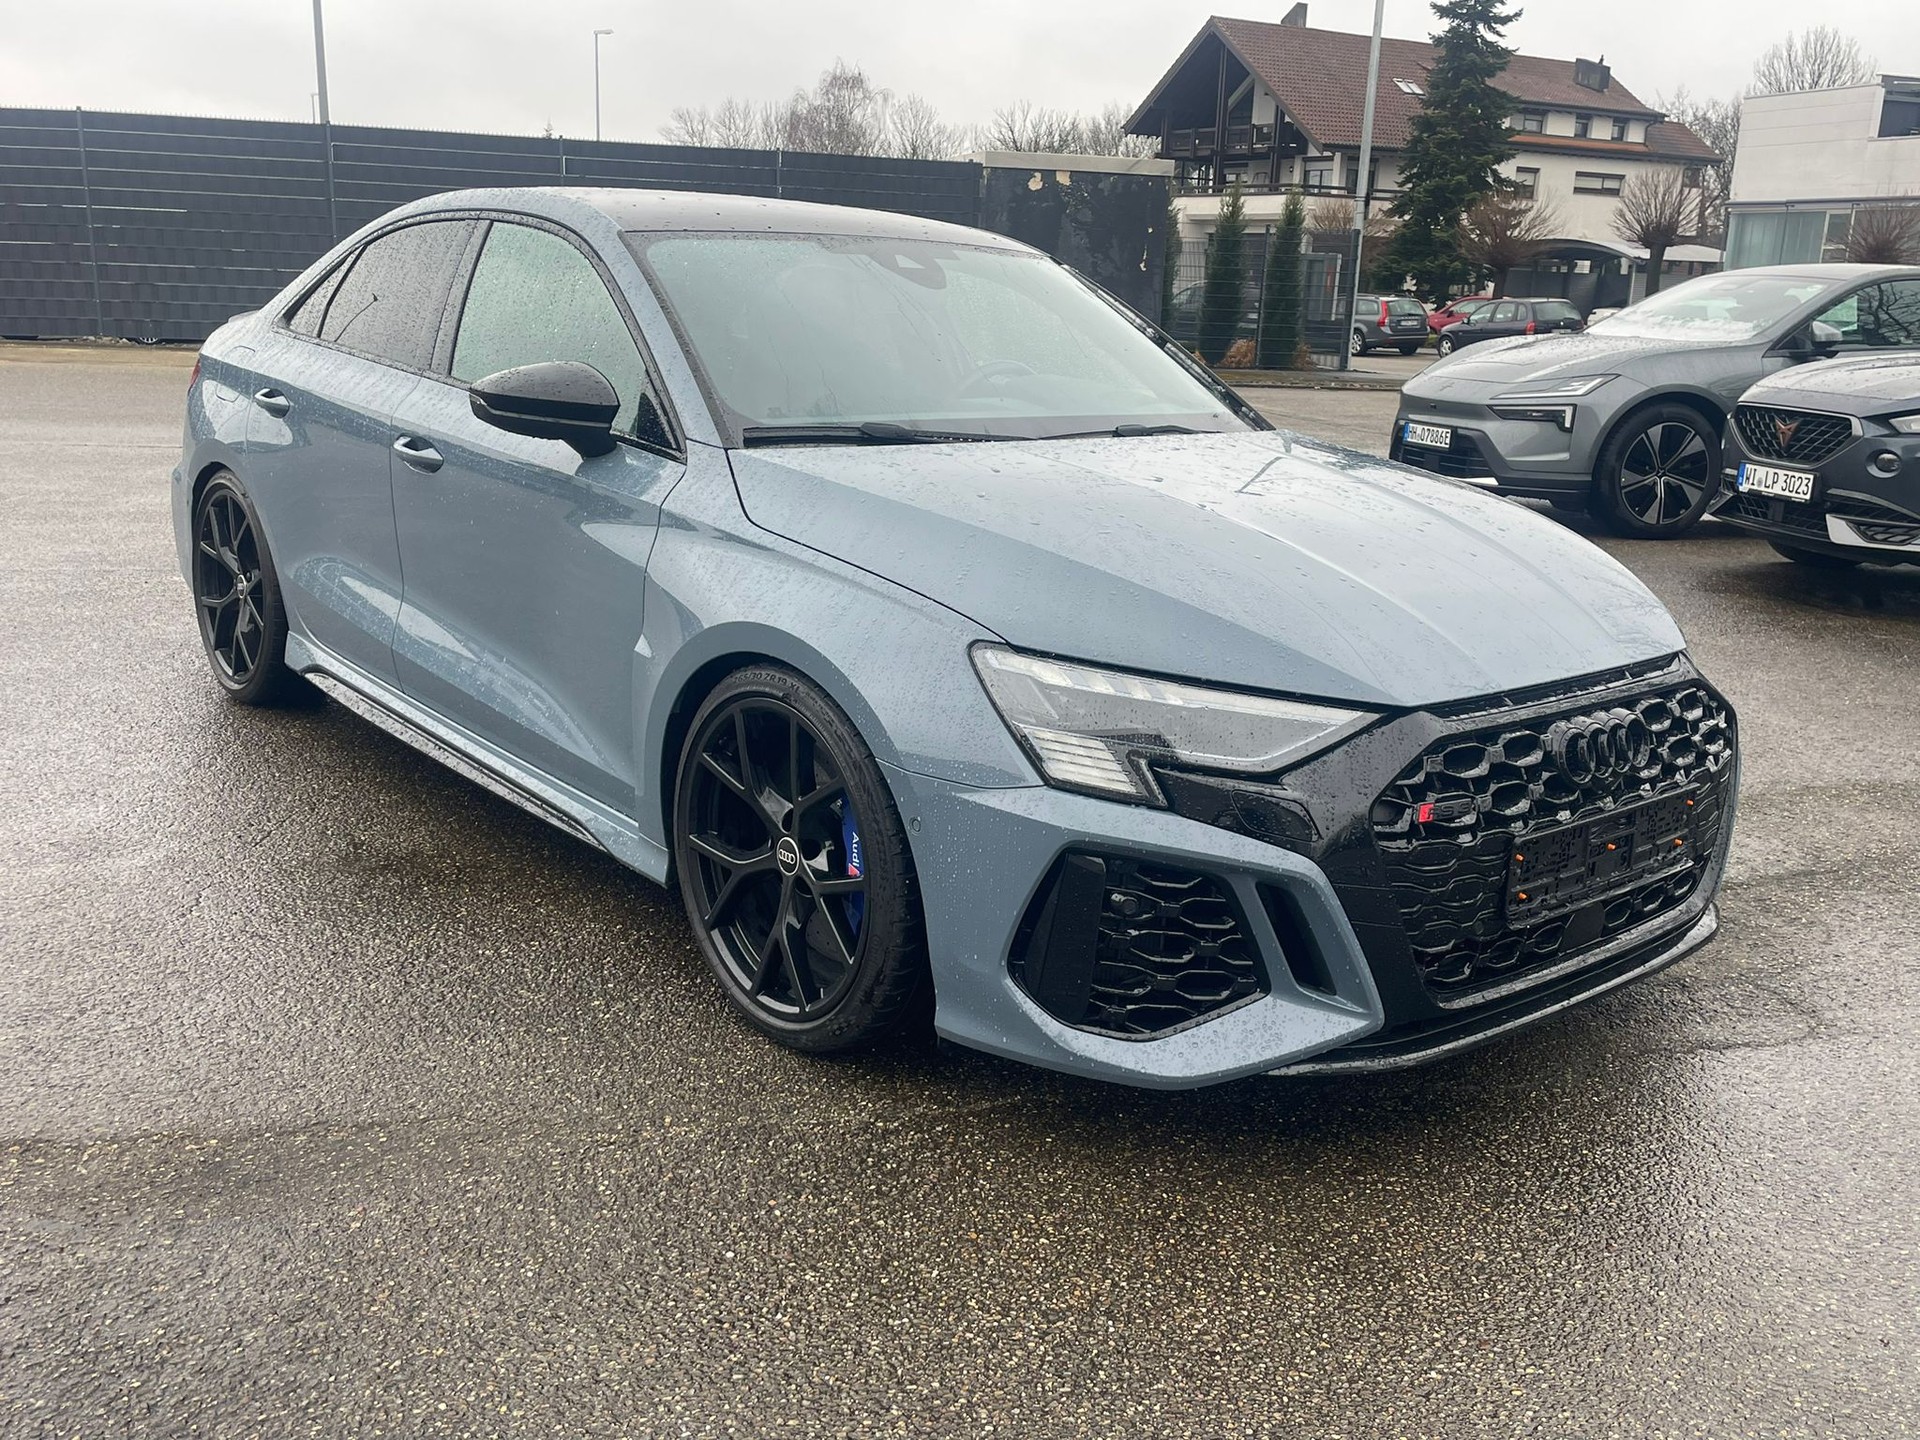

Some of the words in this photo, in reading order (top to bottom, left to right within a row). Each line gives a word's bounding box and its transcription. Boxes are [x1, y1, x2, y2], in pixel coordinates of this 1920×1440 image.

[1764, 470, 1779, 490] LP
[1781, 473, 1811, 496] 3023
[852, 831, 860, 867] Audi
